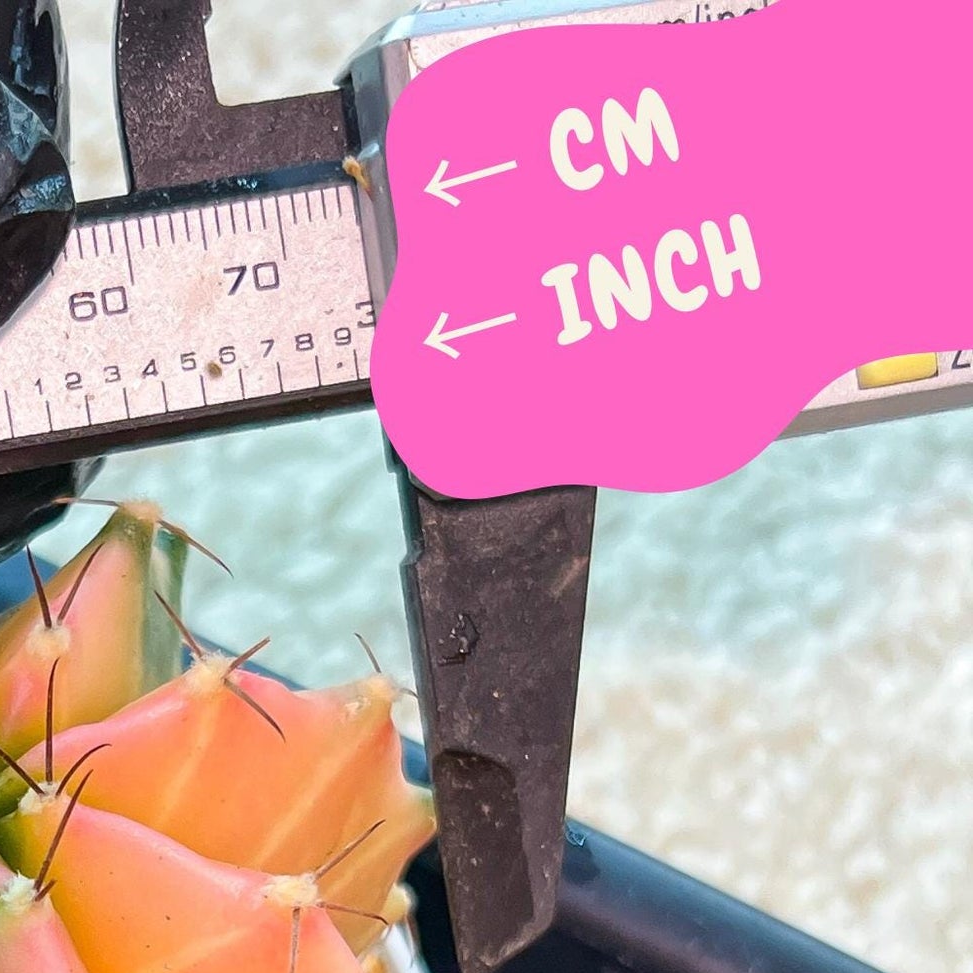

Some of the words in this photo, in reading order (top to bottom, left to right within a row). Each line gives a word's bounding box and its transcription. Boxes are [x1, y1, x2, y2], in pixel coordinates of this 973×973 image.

[67, 285, 129, 323] 60
[222, 260, 281, 296] 70
[34, 377, 44, 396] 1
[64, 371, 83, 391] 2
[102, 364, 122, 384] 3
[141, 358, 159, 379] 4
[179, 351, 197, 372] 5
[218, 345, 237, 366] 6
[260, 338, 275, 358] 7
[294, 332, 315, 352] 8
[333, 326, 352, 347] 9
